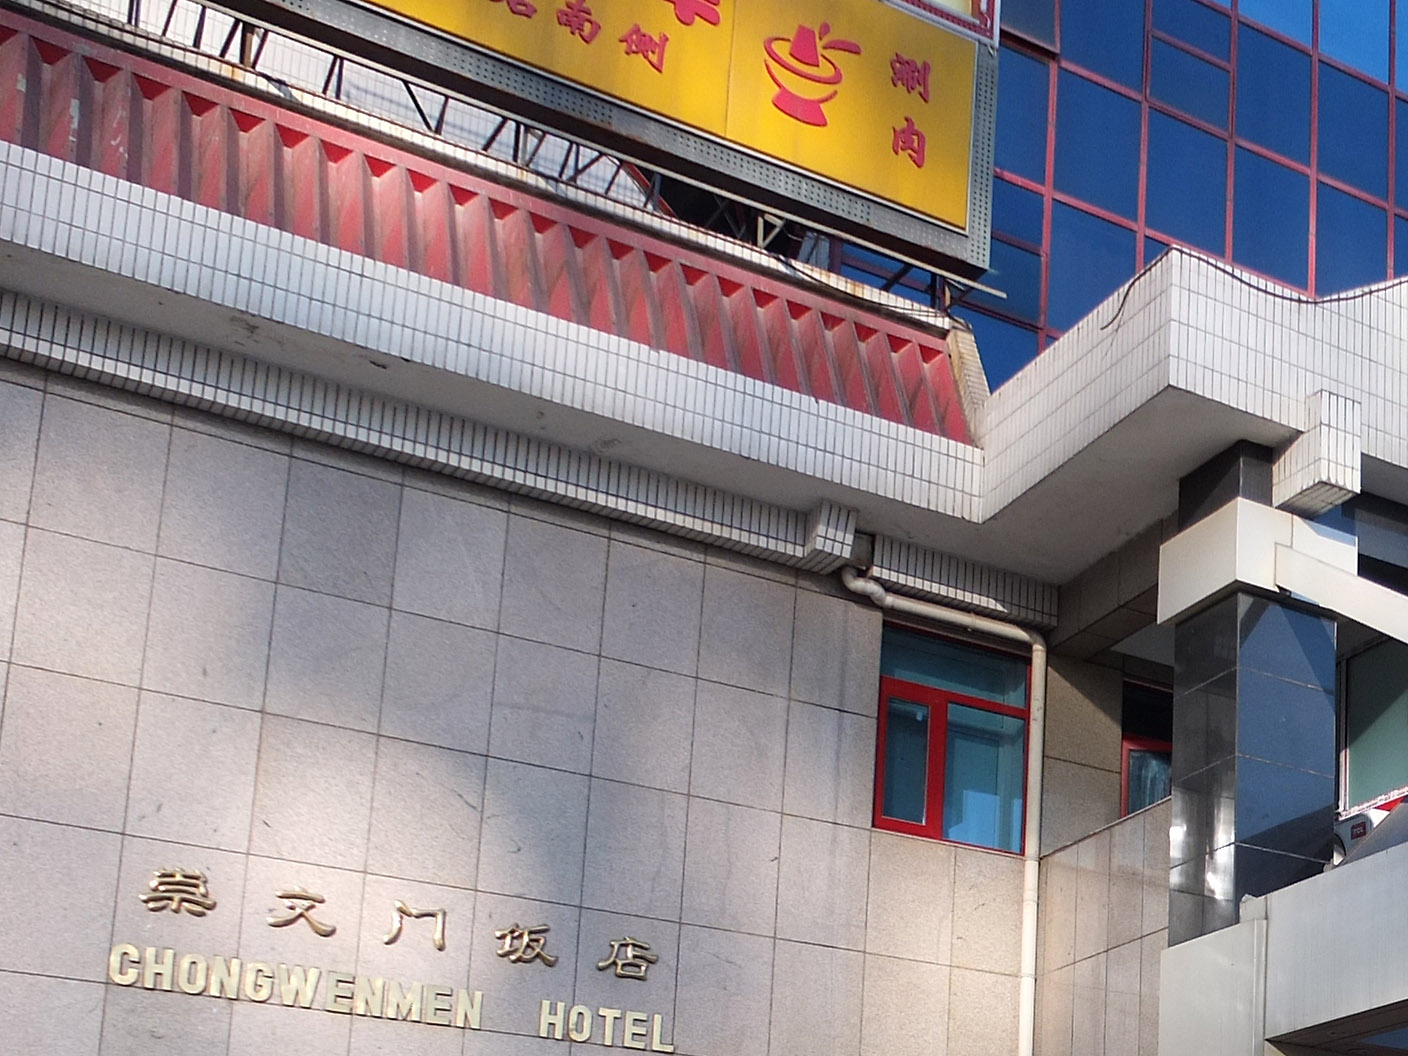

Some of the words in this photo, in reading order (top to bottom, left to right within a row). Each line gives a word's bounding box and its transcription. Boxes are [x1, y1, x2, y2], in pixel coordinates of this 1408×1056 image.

[139, 866, 659, 981] 崇文门饭店
[108, 943, 484, 1030] CHONGWENMEN
[538, 999, 676, 1053] HOTEL
